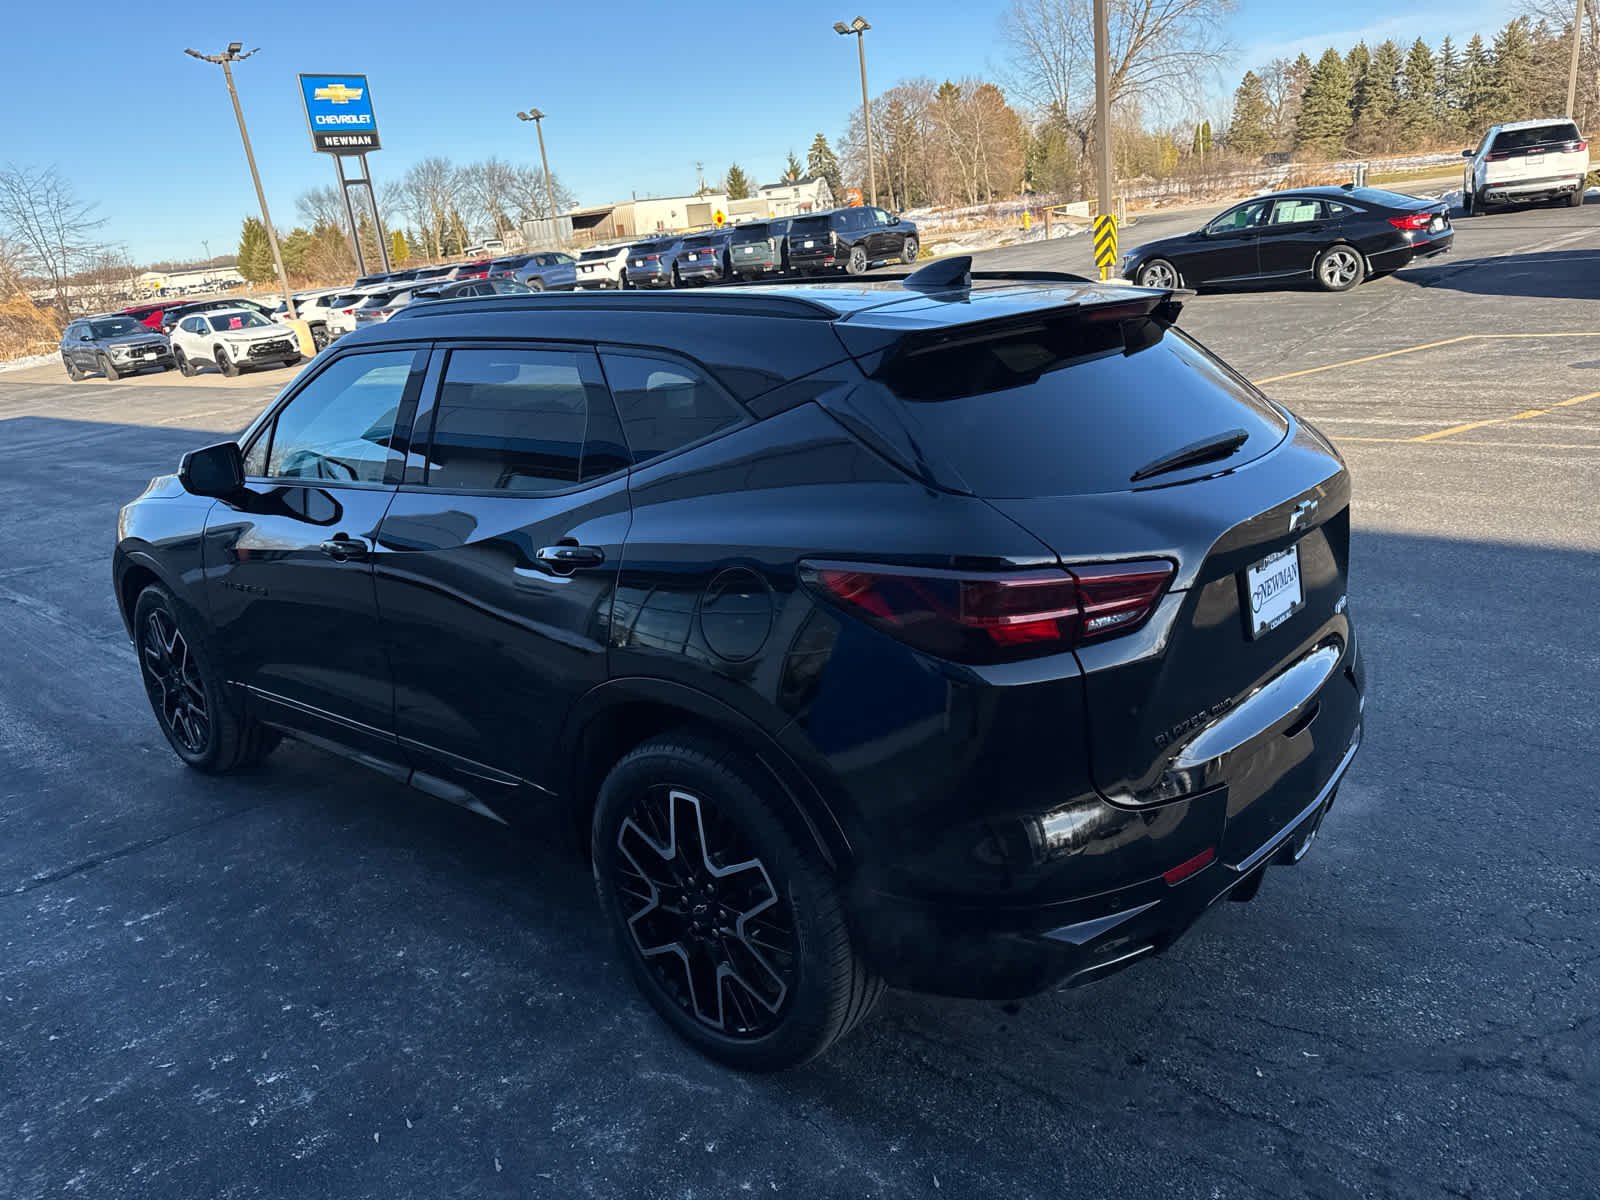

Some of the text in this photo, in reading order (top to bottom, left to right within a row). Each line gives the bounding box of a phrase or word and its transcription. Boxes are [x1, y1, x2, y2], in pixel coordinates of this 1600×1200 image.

[315, 114, 371, 125] CHEVROLET
[324, 135, 372, 146] NEWMAN
[1254, 562, 1298, 606] NEWMAN
